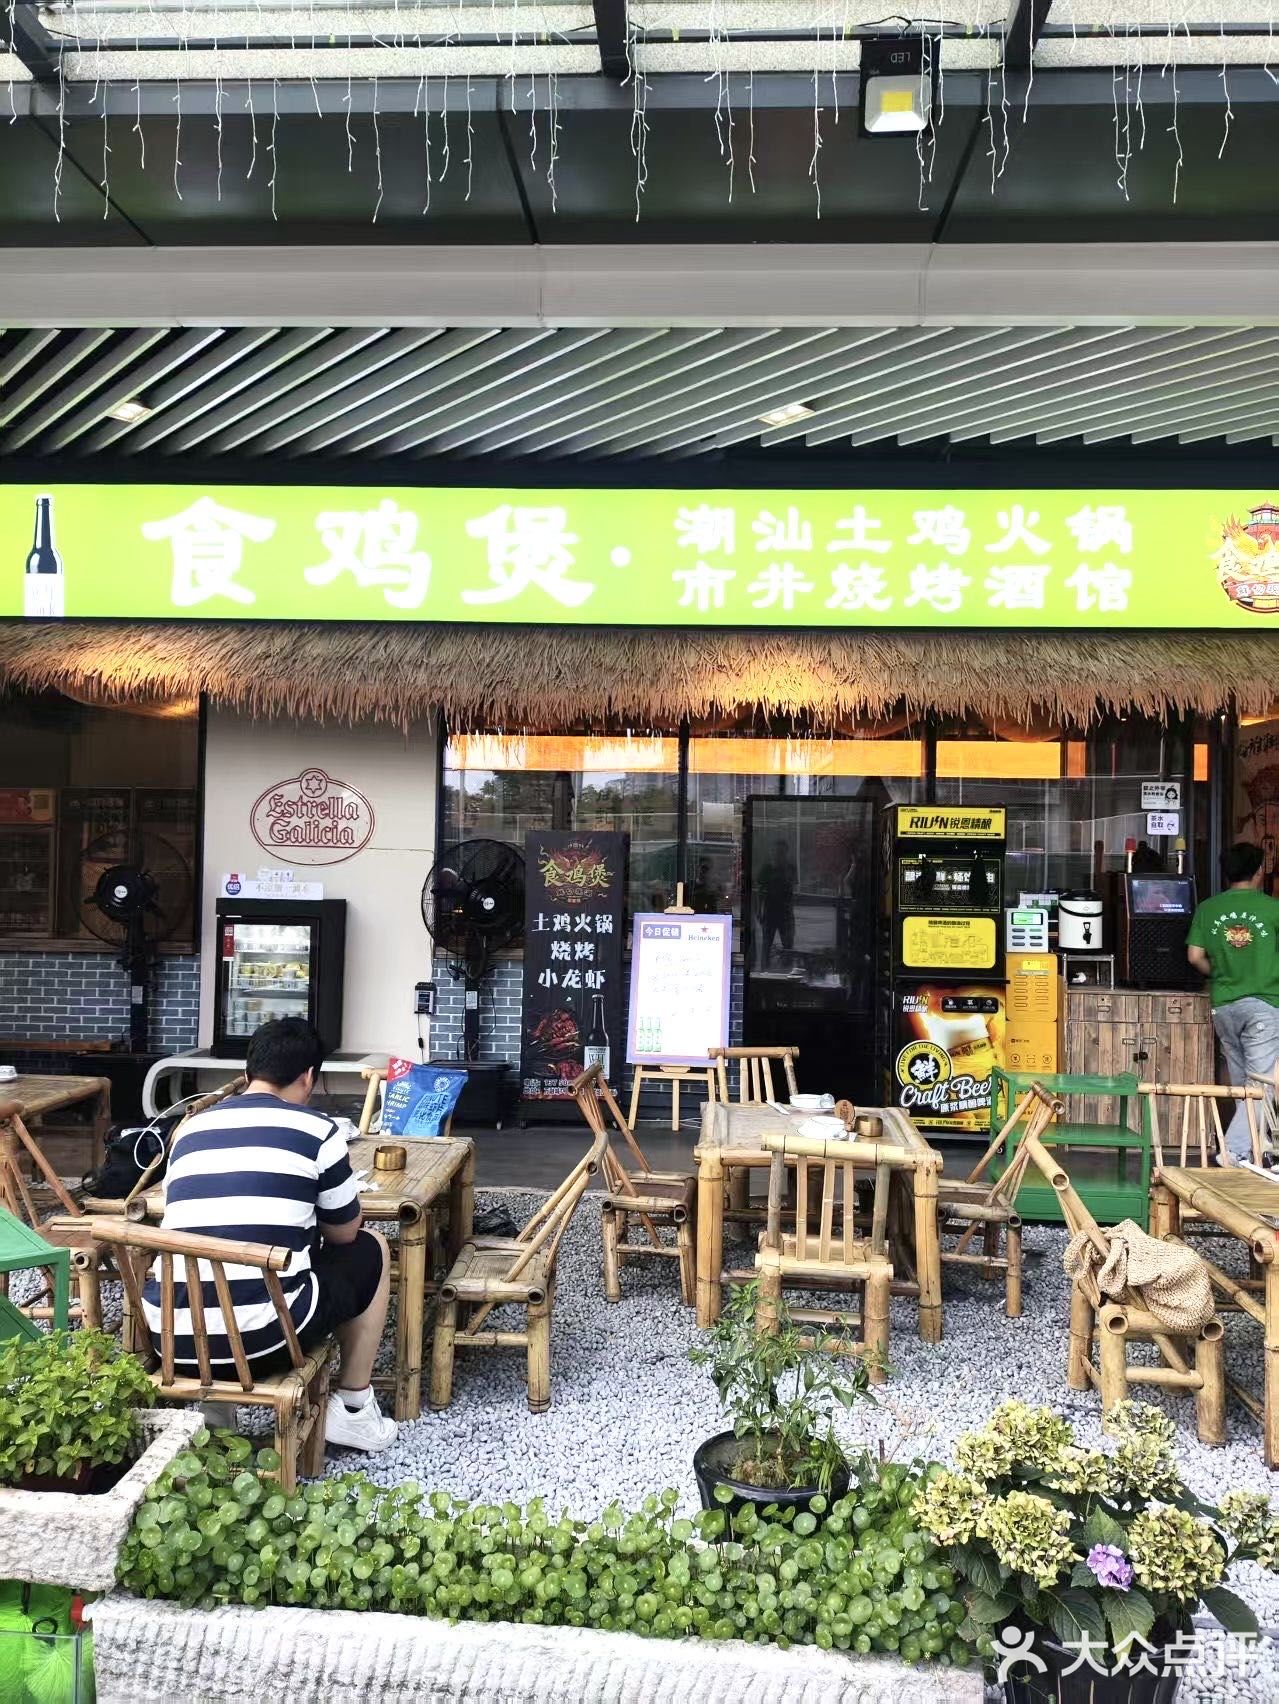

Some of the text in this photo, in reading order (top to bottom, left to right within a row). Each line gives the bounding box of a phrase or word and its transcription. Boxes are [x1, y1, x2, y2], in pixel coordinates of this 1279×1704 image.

[890, 51, 911, 63] LED
[673, 504, 1134, 555] 潮汕土鸡火锅
[672, 561, 1134, 613] 市井烧烤酒馆
[265, 793, 360, 821] Estrella
[269, 818, 355, 845] Galicia
[539, 858, 611, 888] 食鸡煲
[531, 912, 613, 934] 土鸡火锅
[644, 926, 680, 938] 今日促销
[688, 934, 721, 942] Heineken
[551, 940, 596, 961] 烧烤
[537, 968, 606, 990] 小龙虾
[900, 1081, 950, 1110] Craft
